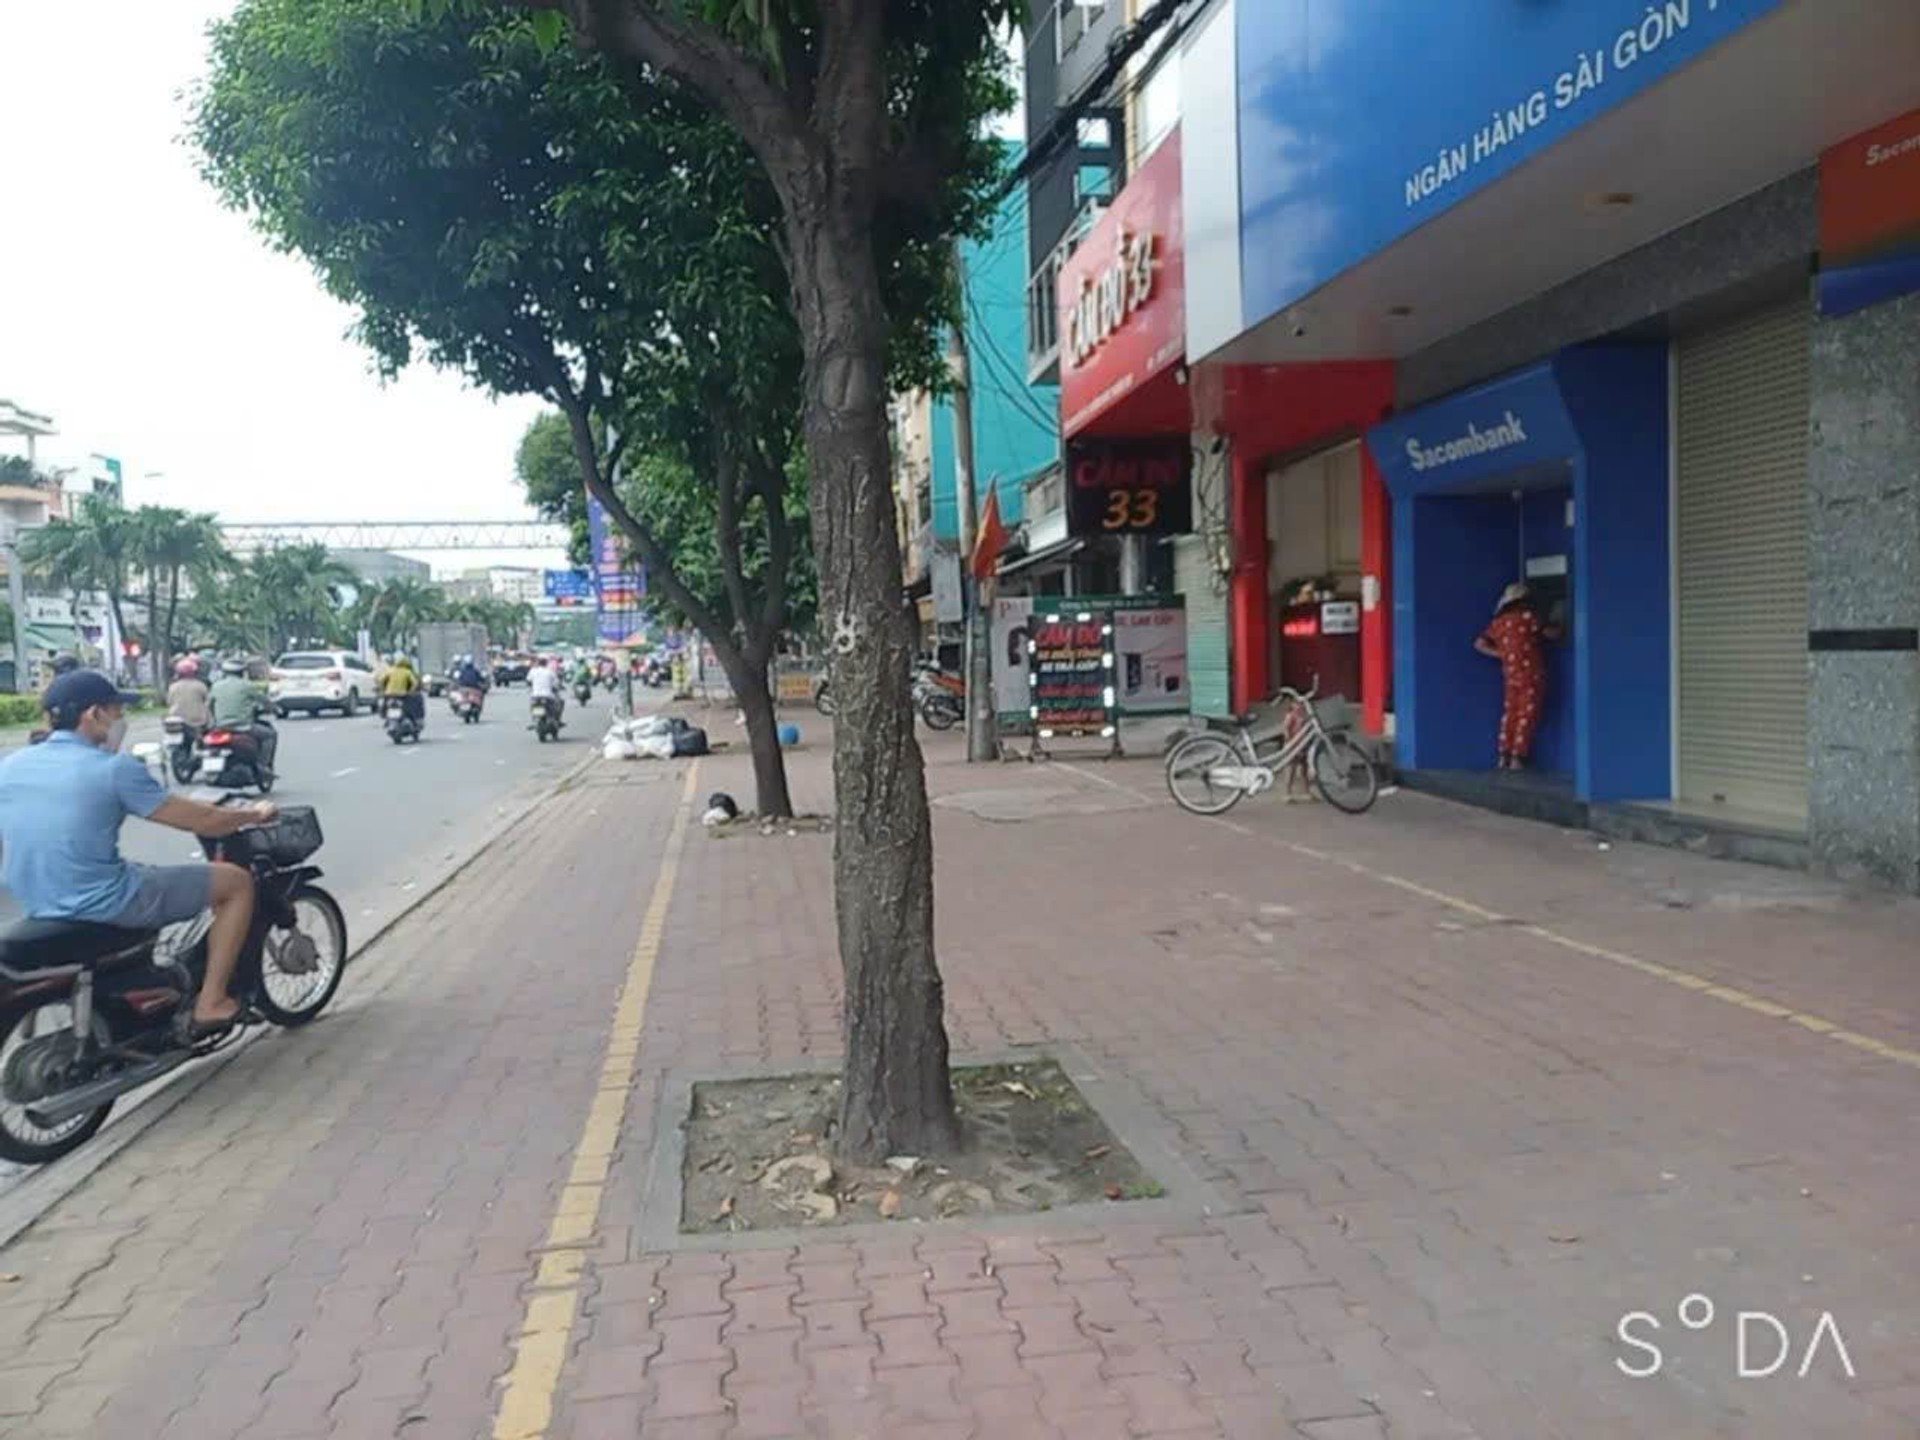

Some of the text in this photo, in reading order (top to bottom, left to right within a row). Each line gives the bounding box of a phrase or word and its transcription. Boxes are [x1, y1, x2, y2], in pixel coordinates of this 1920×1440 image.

[1405, 0, 1689, 206] NGÂN HÀNG SÀI GÒN
[1406, 409, 1527, 471] Sacombank
[1102, 488, 1157, 528] 33
